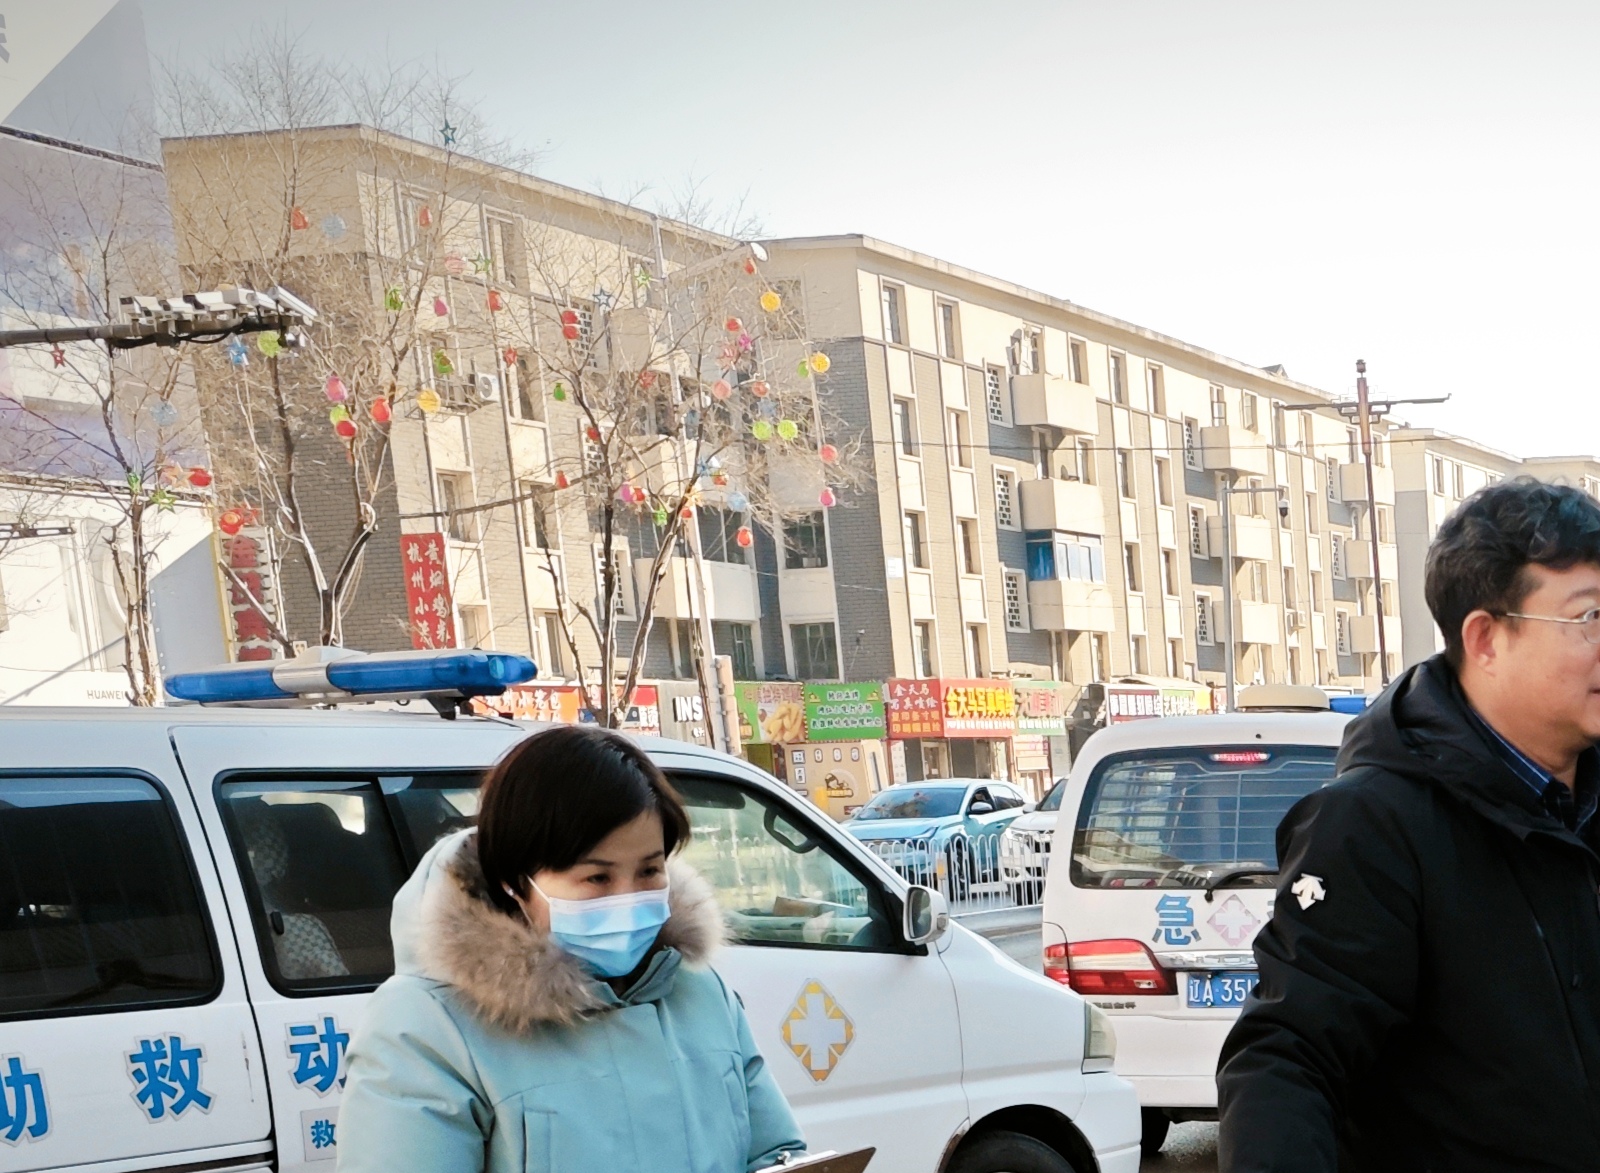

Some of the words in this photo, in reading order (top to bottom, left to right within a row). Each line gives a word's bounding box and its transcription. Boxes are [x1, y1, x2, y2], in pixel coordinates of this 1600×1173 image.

[407, 542, 436, 650] 杭州小笼
[425, 541, 450, 650] 黄焖鸡米
[87, 690, 125, 700] HUAWEI
[1152, 894, 1202, 946] 急
